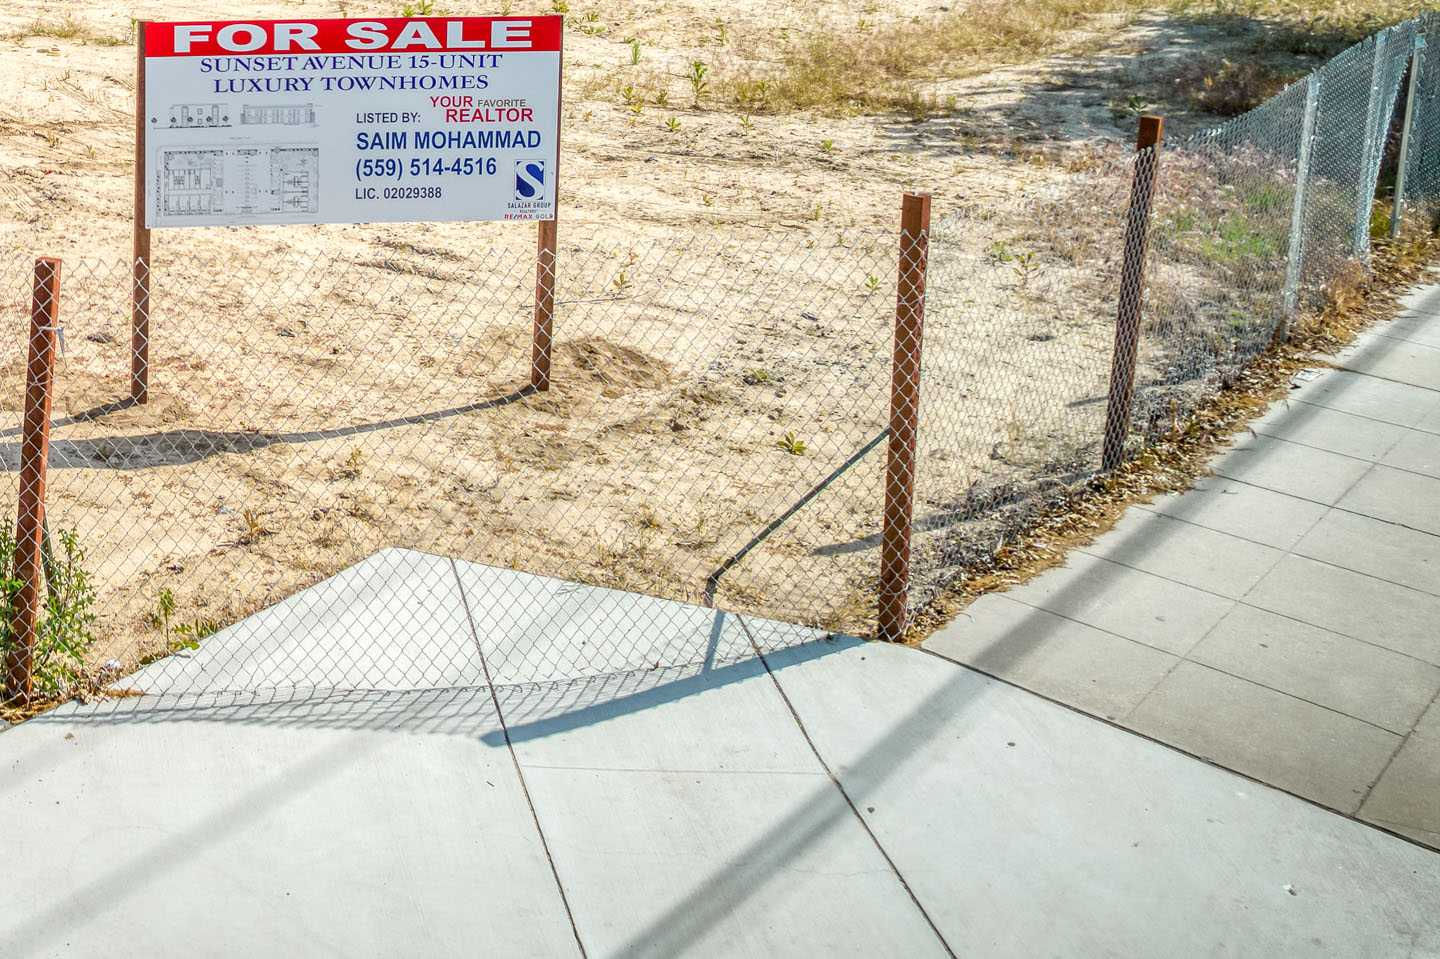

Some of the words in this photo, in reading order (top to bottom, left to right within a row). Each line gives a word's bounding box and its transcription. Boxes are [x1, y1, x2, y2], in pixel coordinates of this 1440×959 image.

[173, 23, 322, 53] FOR
[344, 20, 533, 51] SALE
[200, 56, 298, 73] SUNSET
[303, 54, 402, 71] AVENUE
[409, 53, 503, 70] 15-UNIT
[213, 77, 314, 93] LUXURY
[321, 74, 489, 92] TOWNHOMES
[430, 96, 473, 108] YOUR
[477, 99, 527, 108] FAVORITE
[356, 112, 398, 124] LISTED
[401, 111, 421, 123] BY:
[445, 108, 534, 123] REALTOR
[356, 132, 407, 150] SAIM
[414, 130, 542, 149] MOHAMMAD
[355, 157, 403, 182] (559)
[410, 156, 497, 176] 514-4516
[355, 187, 380, 200] LIC.
[383, 186, 442, 200] 02029388
